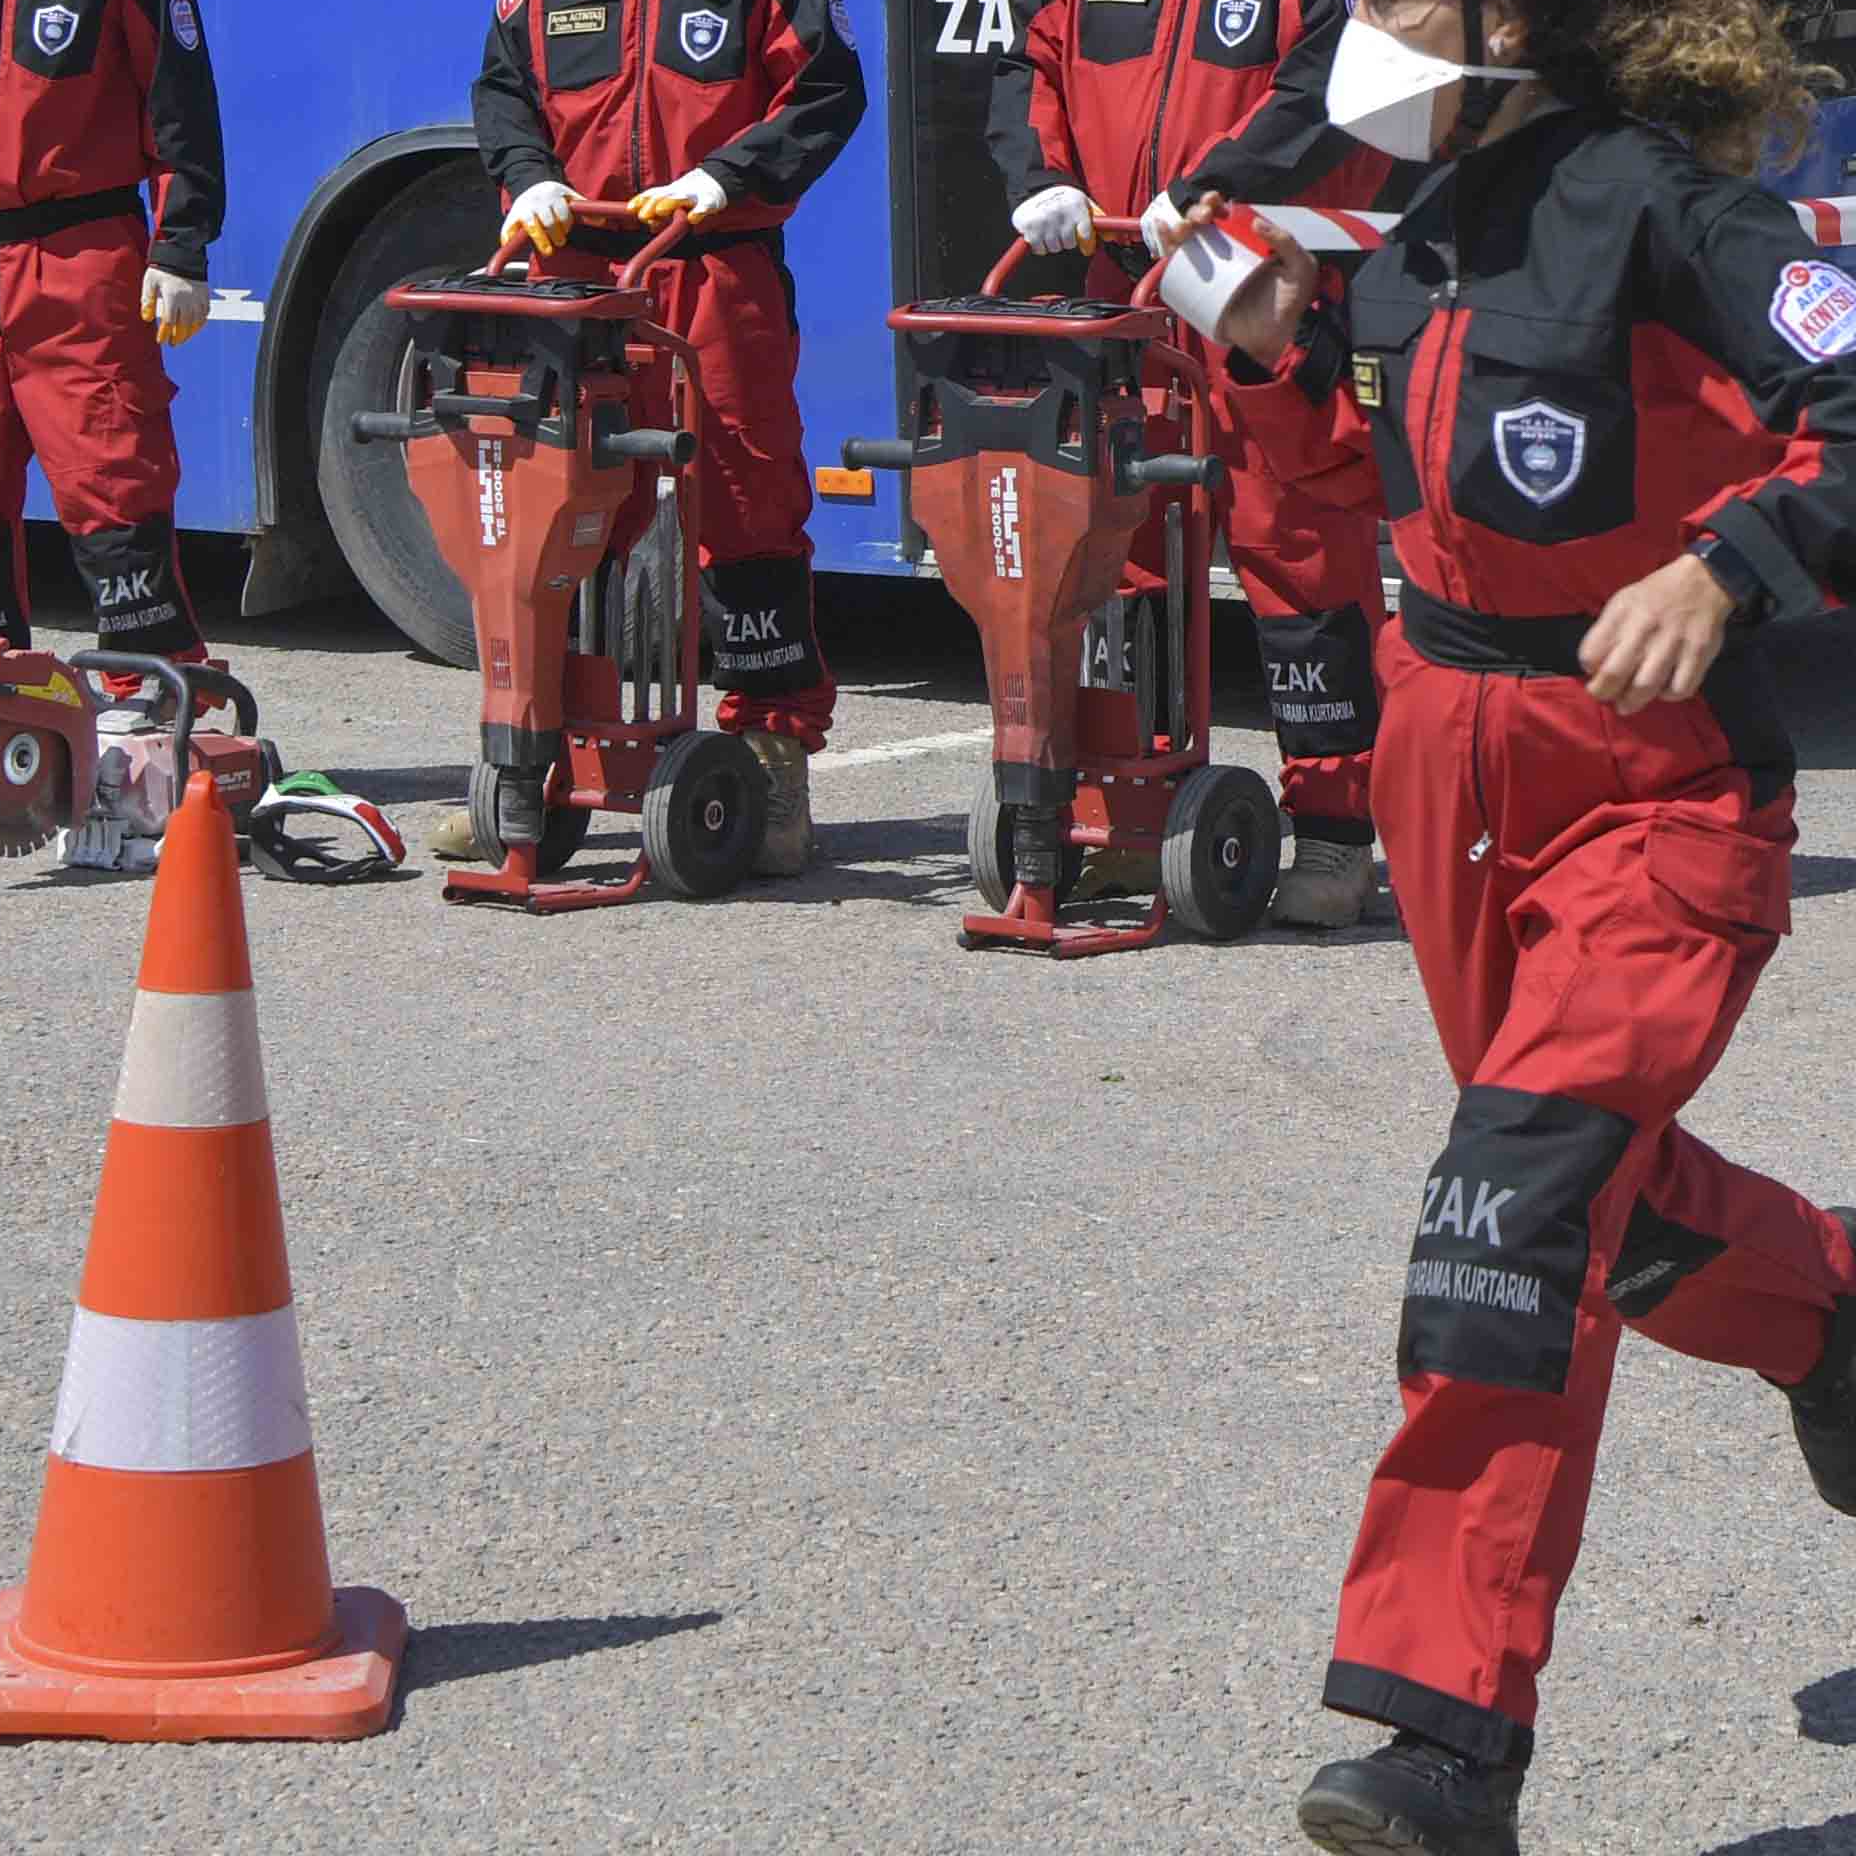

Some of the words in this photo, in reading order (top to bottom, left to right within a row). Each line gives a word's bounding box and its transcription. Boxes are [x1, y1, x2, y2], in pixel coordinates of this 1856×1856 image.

[1796, 275, 1833, 312] AFAD
[478, 439, 497, 546] HILTI
[1001, 467, 1024, 578] HILTI
[97, 569, 154, 607] ZAK
[723, 609, 782, 642] ZAK
[1267, 662, 1328, 692] ZAK
[1308, 699, 1357, 723] KURTARMA
[1419, 1175, 1517, 1247] ZAK
[1451, 1263, 1541, 1315] KURTARMA
